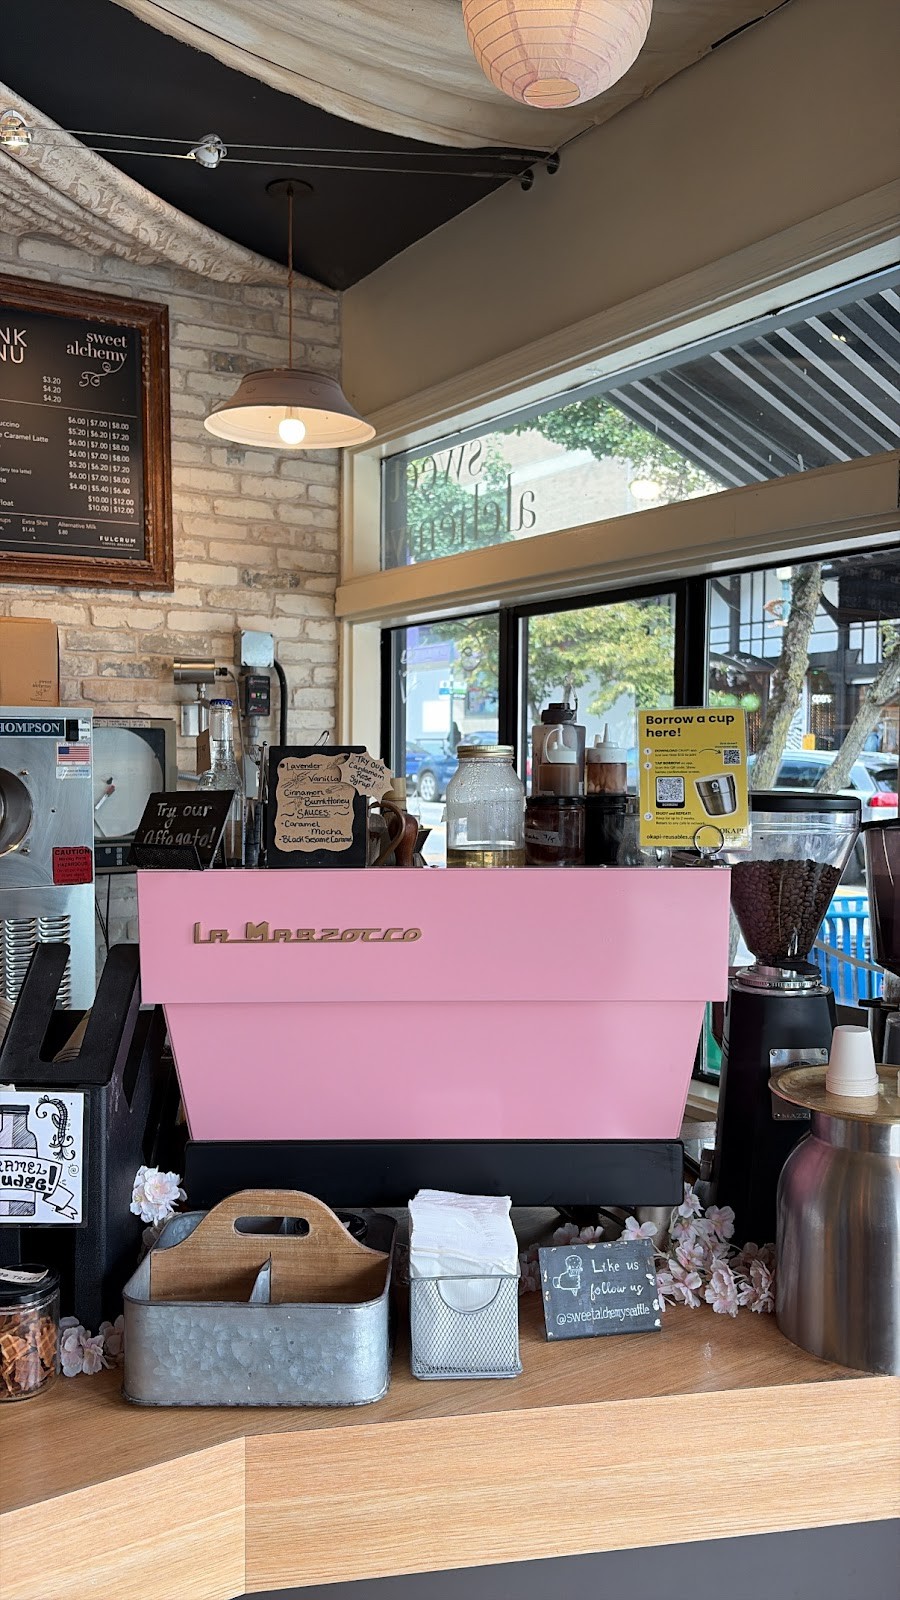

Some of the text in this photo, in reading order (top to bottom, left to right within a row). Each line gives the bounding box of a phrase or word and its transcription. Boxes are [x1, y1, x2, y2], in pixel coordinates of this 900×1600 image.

[86, 332, 128, 348] sweet
[66, 341, 128, 363] alchemy
[42, 376, 61, 385] $3.20
[42, 384, 61, 394] $4.20
[43, 394, 62, 403] $4.20
[68, 416, 129, 430] $6.00 $7.00 $8.00
[4, 432, 31, 440] Caramel
[32, 435, 48, 443] Latte
[68, 428, 129, 441] $5.20 $6.20 $7.20
[68, 439, 129, 452] $6.00 $7.00 $8.00
[68, 450, 130, 463] $6.00 $7.00 $8.00
[69, 461, 130, 473] $5.20 $6.20 $7.20
[91, 474, 108, 482] $7.00
[113, 476, 130, 484] $8.00
[69, 483, 130, 495] $4.40 $5.40 $6.40
[88, 496, 134, 506] $10.00 $12.00
[88, 504, 134, 515] $10.00 $12.00
[646, 715, 694, 724] Borrow
[708, 715, 734, 726] cup
[646, 728, 681, 737] here!
[286, 762, 322, 771] Lavender
[356, 756, 385, 774] TRY OUR
[356, 771, 372, 782] Rose
[284, 789, 325, 797] Cinnamon
[157, 802, 212, 829] Try our
[591, 1258, 639, 1273] Like us
[590, 1281, 644, 1301] follow us
